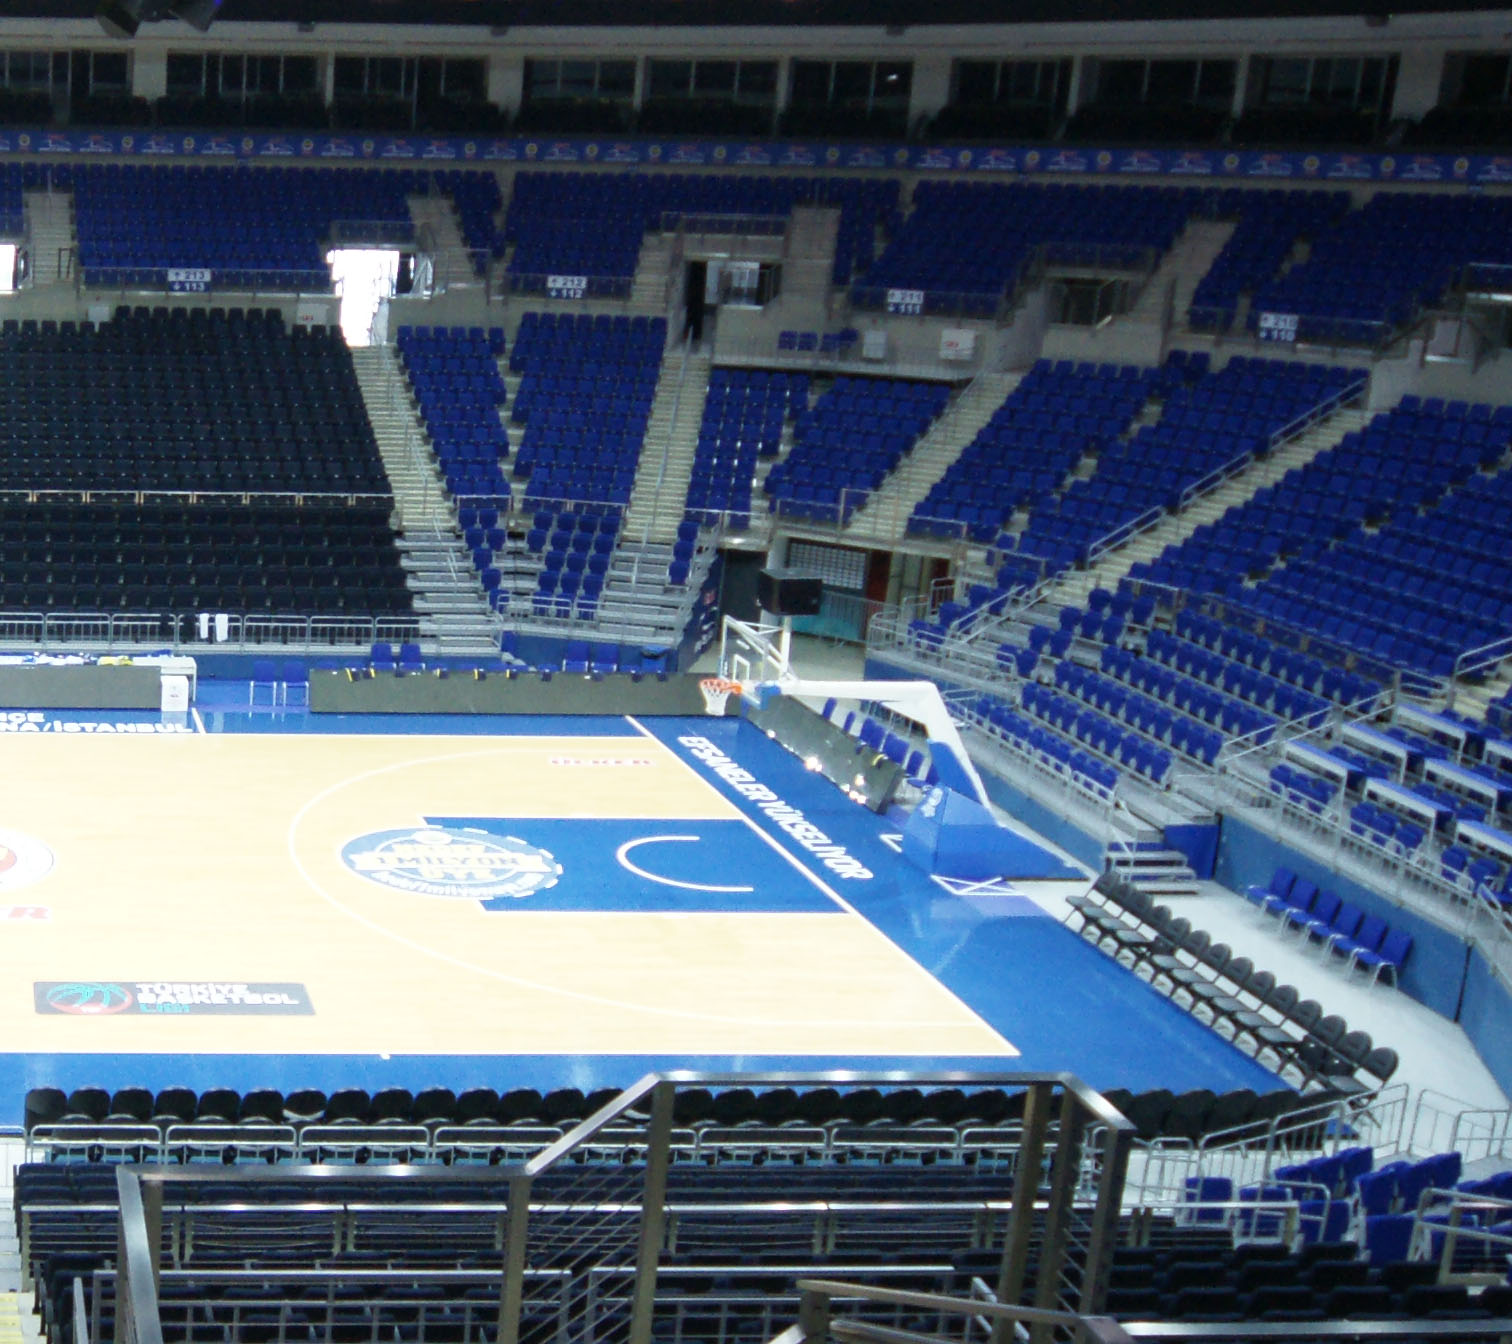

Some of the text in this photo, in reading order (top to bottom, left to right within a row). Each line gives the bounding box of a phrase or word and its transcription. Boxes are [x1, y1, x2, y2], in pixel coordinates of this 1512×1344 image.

[184, 270, 205, 280] 213
[184, 281, 206, 291] 113
[560, 288, 583, 299] 112
[677, 735, 875, 880] EFSANELER YÜKSELİYOR
[136, 982, 249, 995] TÜRKİYE
[137, 993, 300, 1005] BASKETBOL
